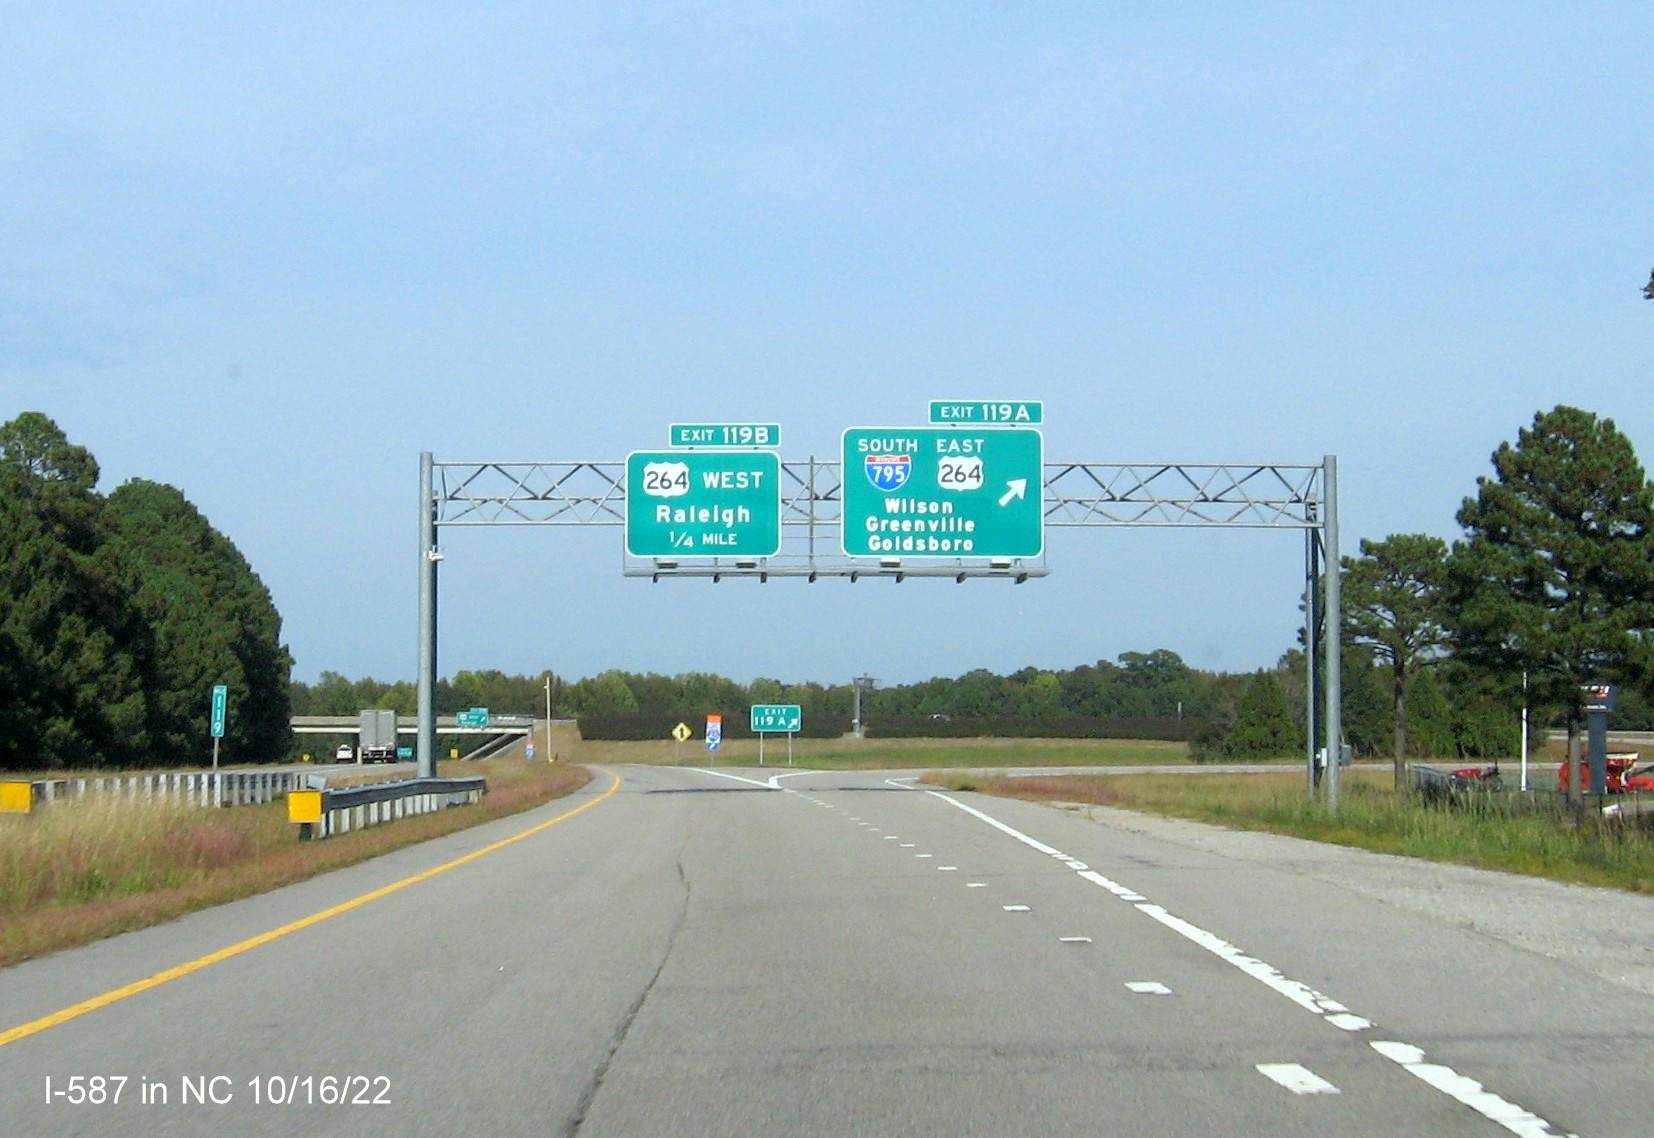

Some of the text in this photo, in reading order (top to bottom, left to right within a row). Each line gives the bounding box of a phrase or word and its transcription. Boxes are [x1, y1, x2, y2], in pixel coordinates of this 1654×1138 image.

[940, 404, 1030, 421] EXIT 119A
[680, 426, 769, 444] EXIT 119B
[858, 438, 918, 452] SOUTH
[936, 439, 985, 453] EAST
[646, 470, 764, 490] 264 WEST
[872, 465, 906, 483] 795
[941, 463, 981, 483] 264
[885, 498, 953, 514] Wilson
[656, 504, 750, 528] Raleigh
[865, 516, 976, 532] Greenville
[702, 533, 737, 546] MILE
[868, 535, 974, 551] Goldsboro
